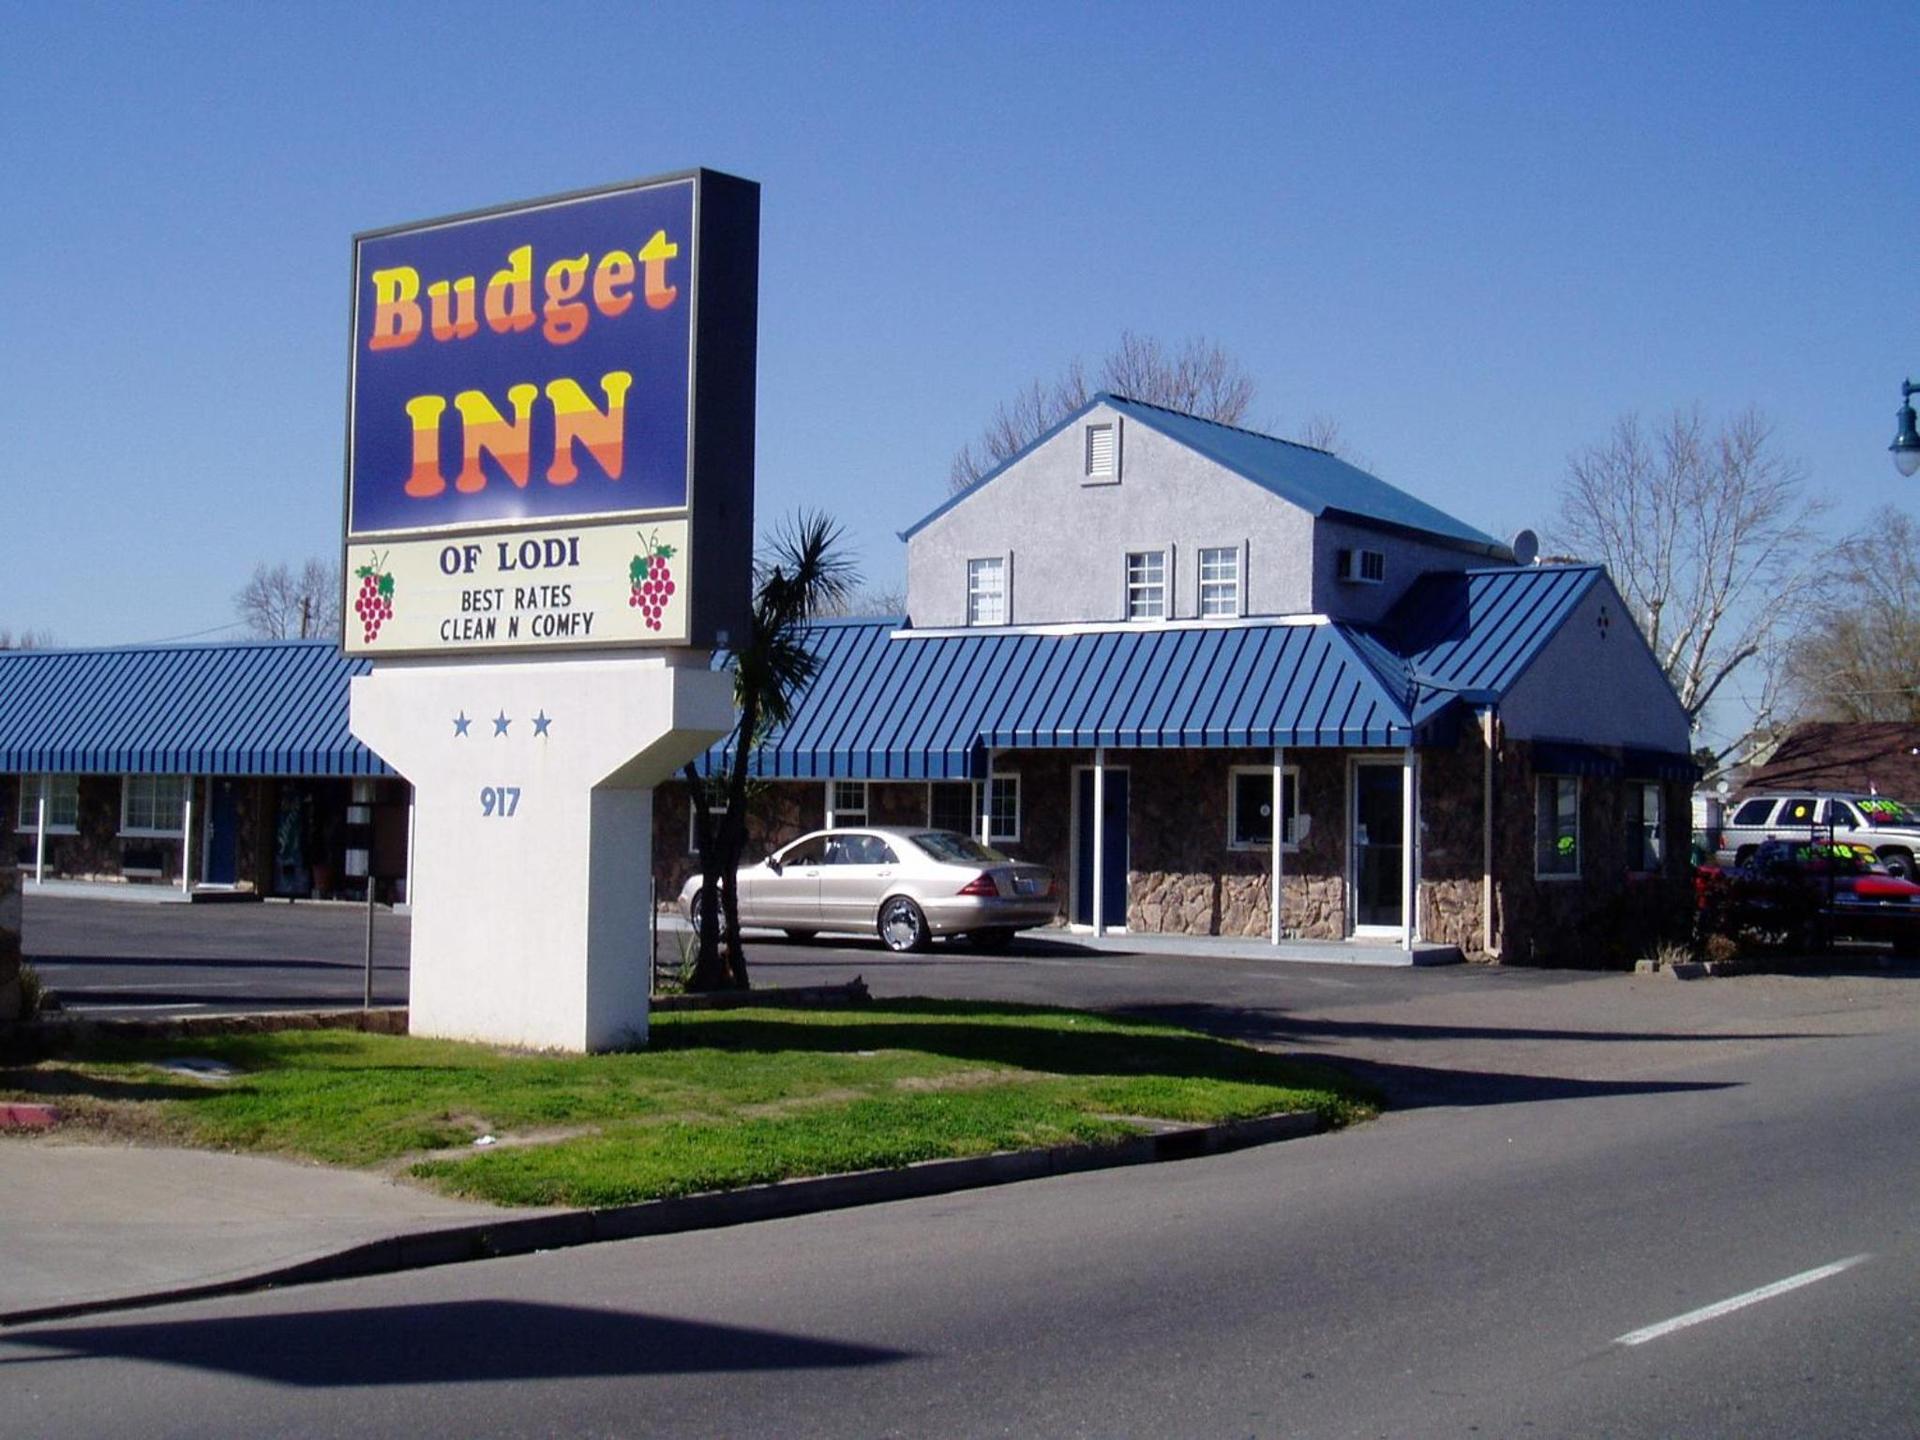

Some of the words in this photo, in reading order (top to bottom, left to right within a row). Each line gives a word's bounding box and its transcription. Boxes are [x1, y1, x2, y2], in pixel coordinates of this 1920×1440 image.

[368, 229, 679, 352] Budget
[404, 370, 633, 498] INN
[439, 545, 482, 575] OF
[497, 537, 580, 571] LODI
[461, 588, 504, 612] BEST
[514, 584, 572, 610] RATES
[440, 617, 496, 641] CLEAN
[508, 616, 519, 638] N
[531, 612, 594, 637] COMFY
[480, 787, 521, 817] 917
